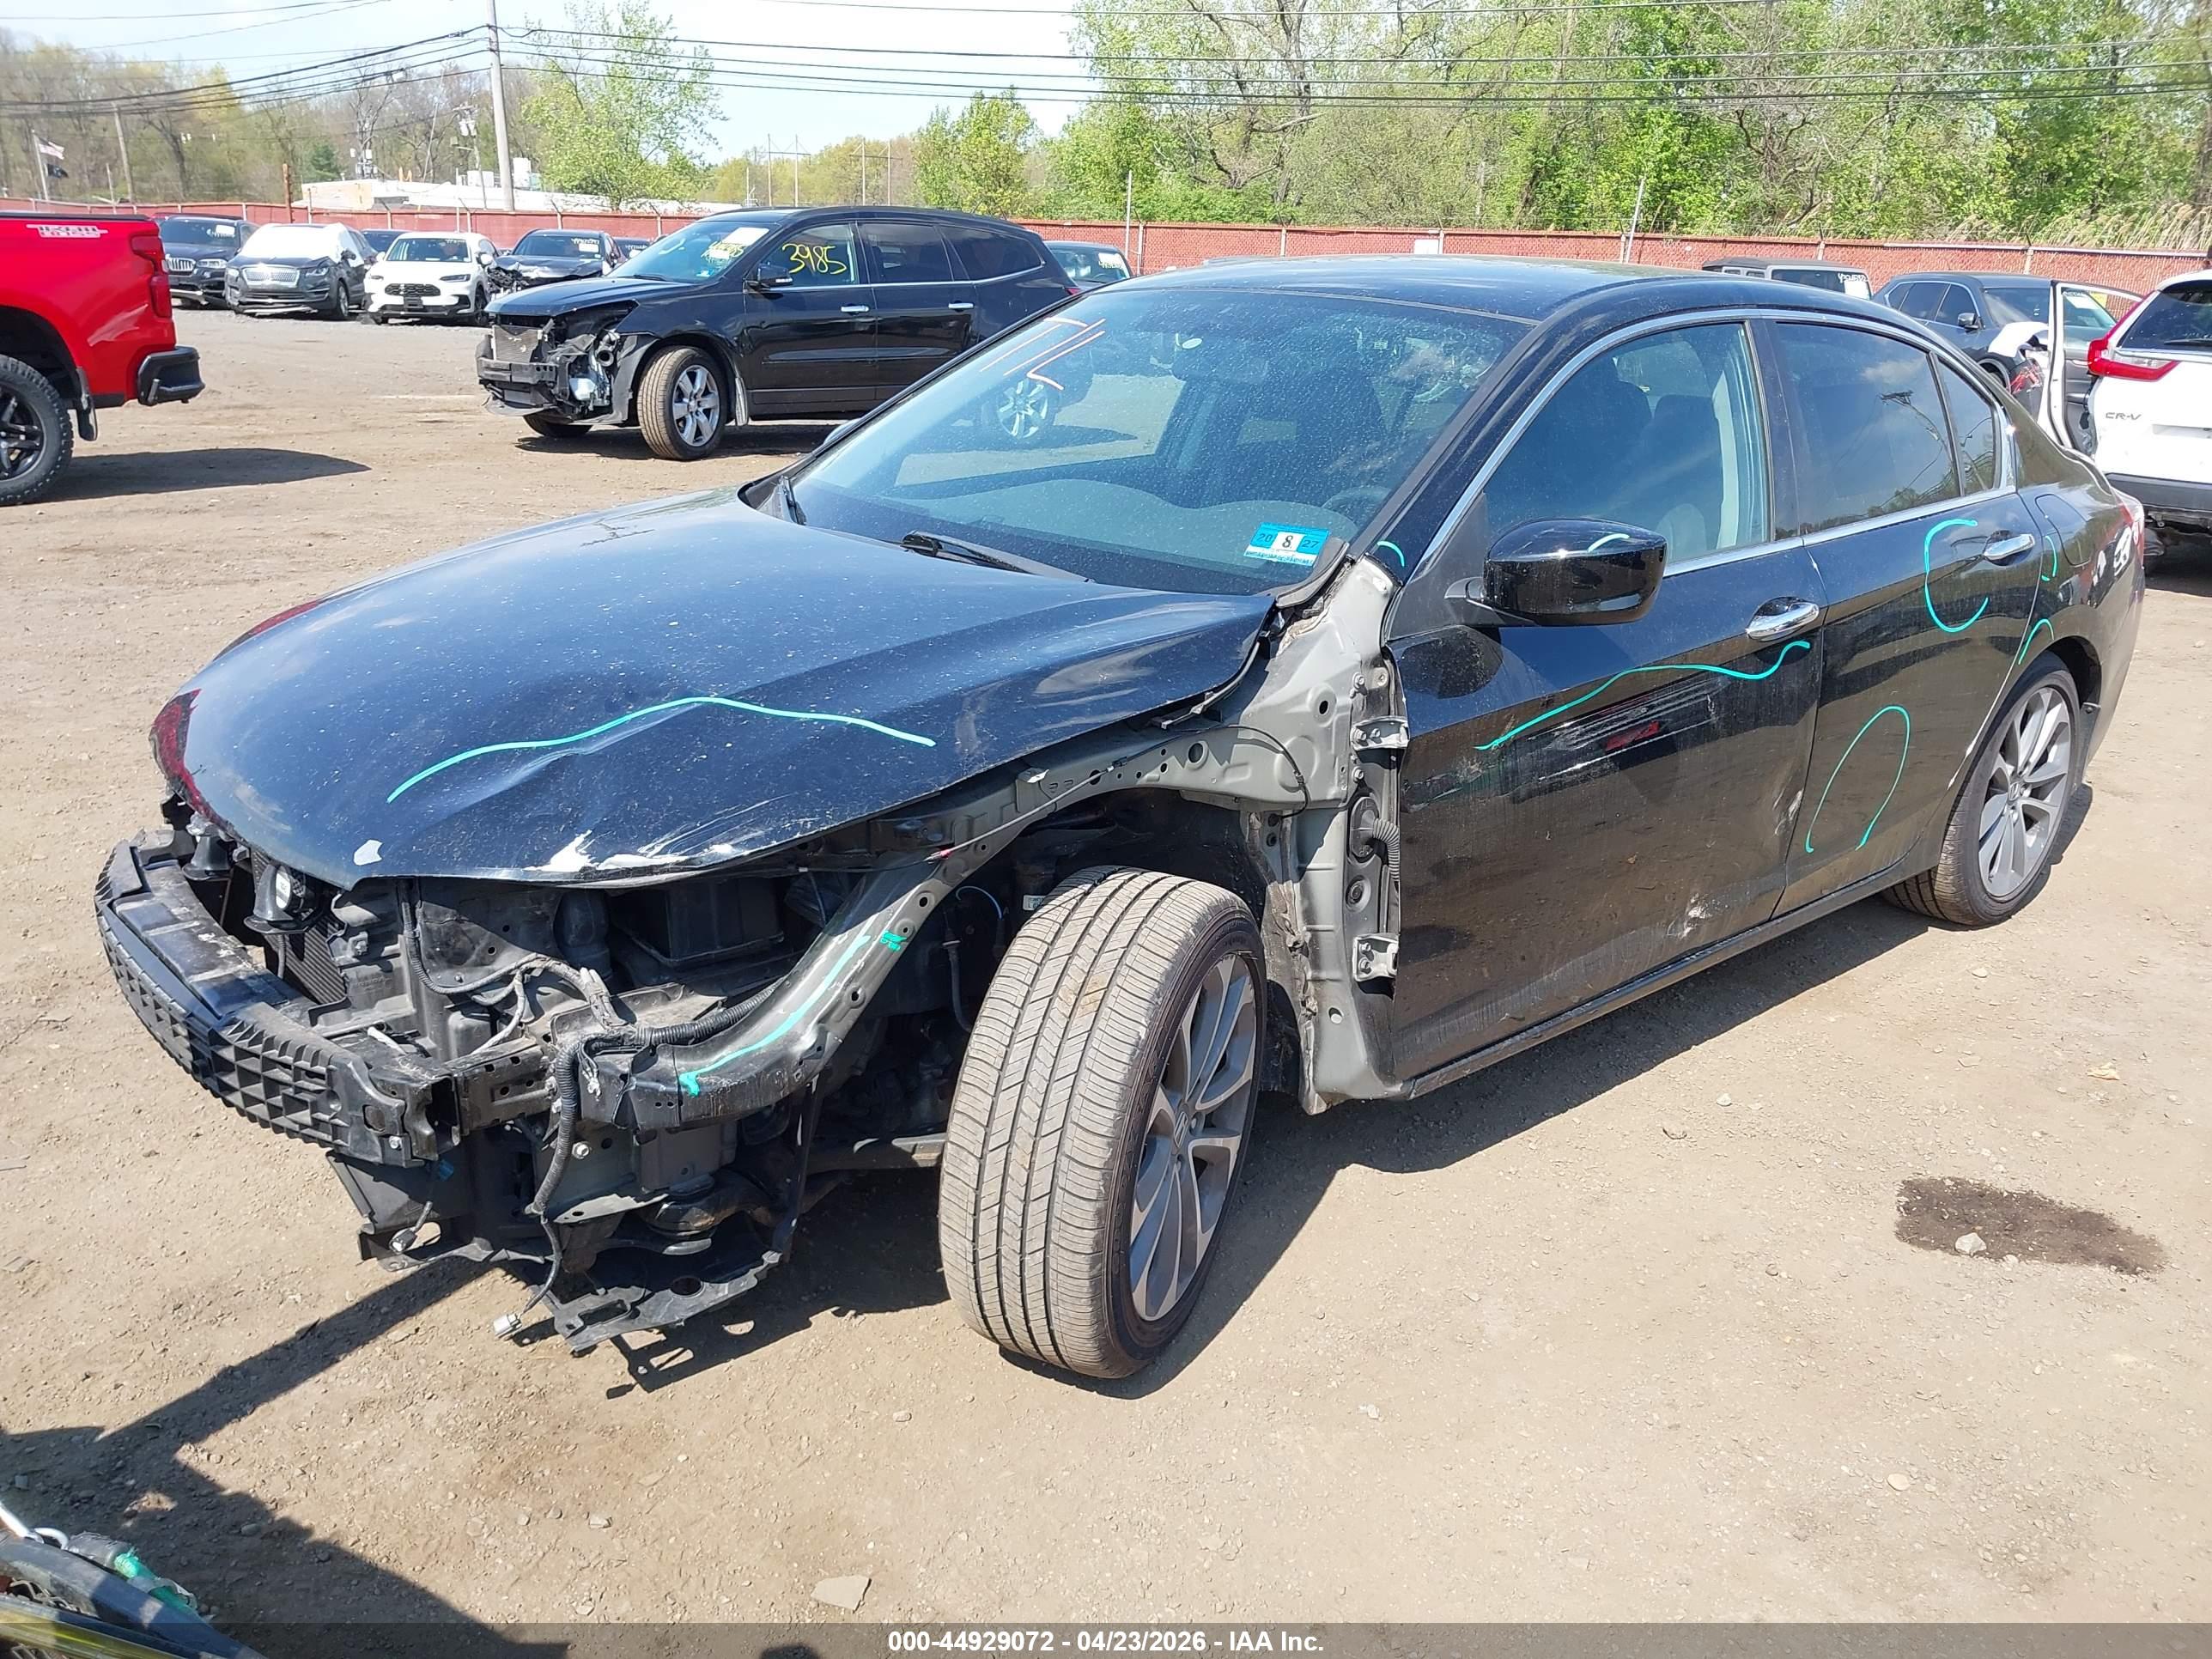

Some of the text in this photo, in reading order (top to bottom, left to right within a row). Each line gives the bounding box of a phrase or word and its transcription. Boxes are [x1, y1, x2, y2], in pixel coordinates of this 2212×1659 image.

[782, 243, 848, 275] 3985
[1257, 533, 1319, 548] 20 8 27
